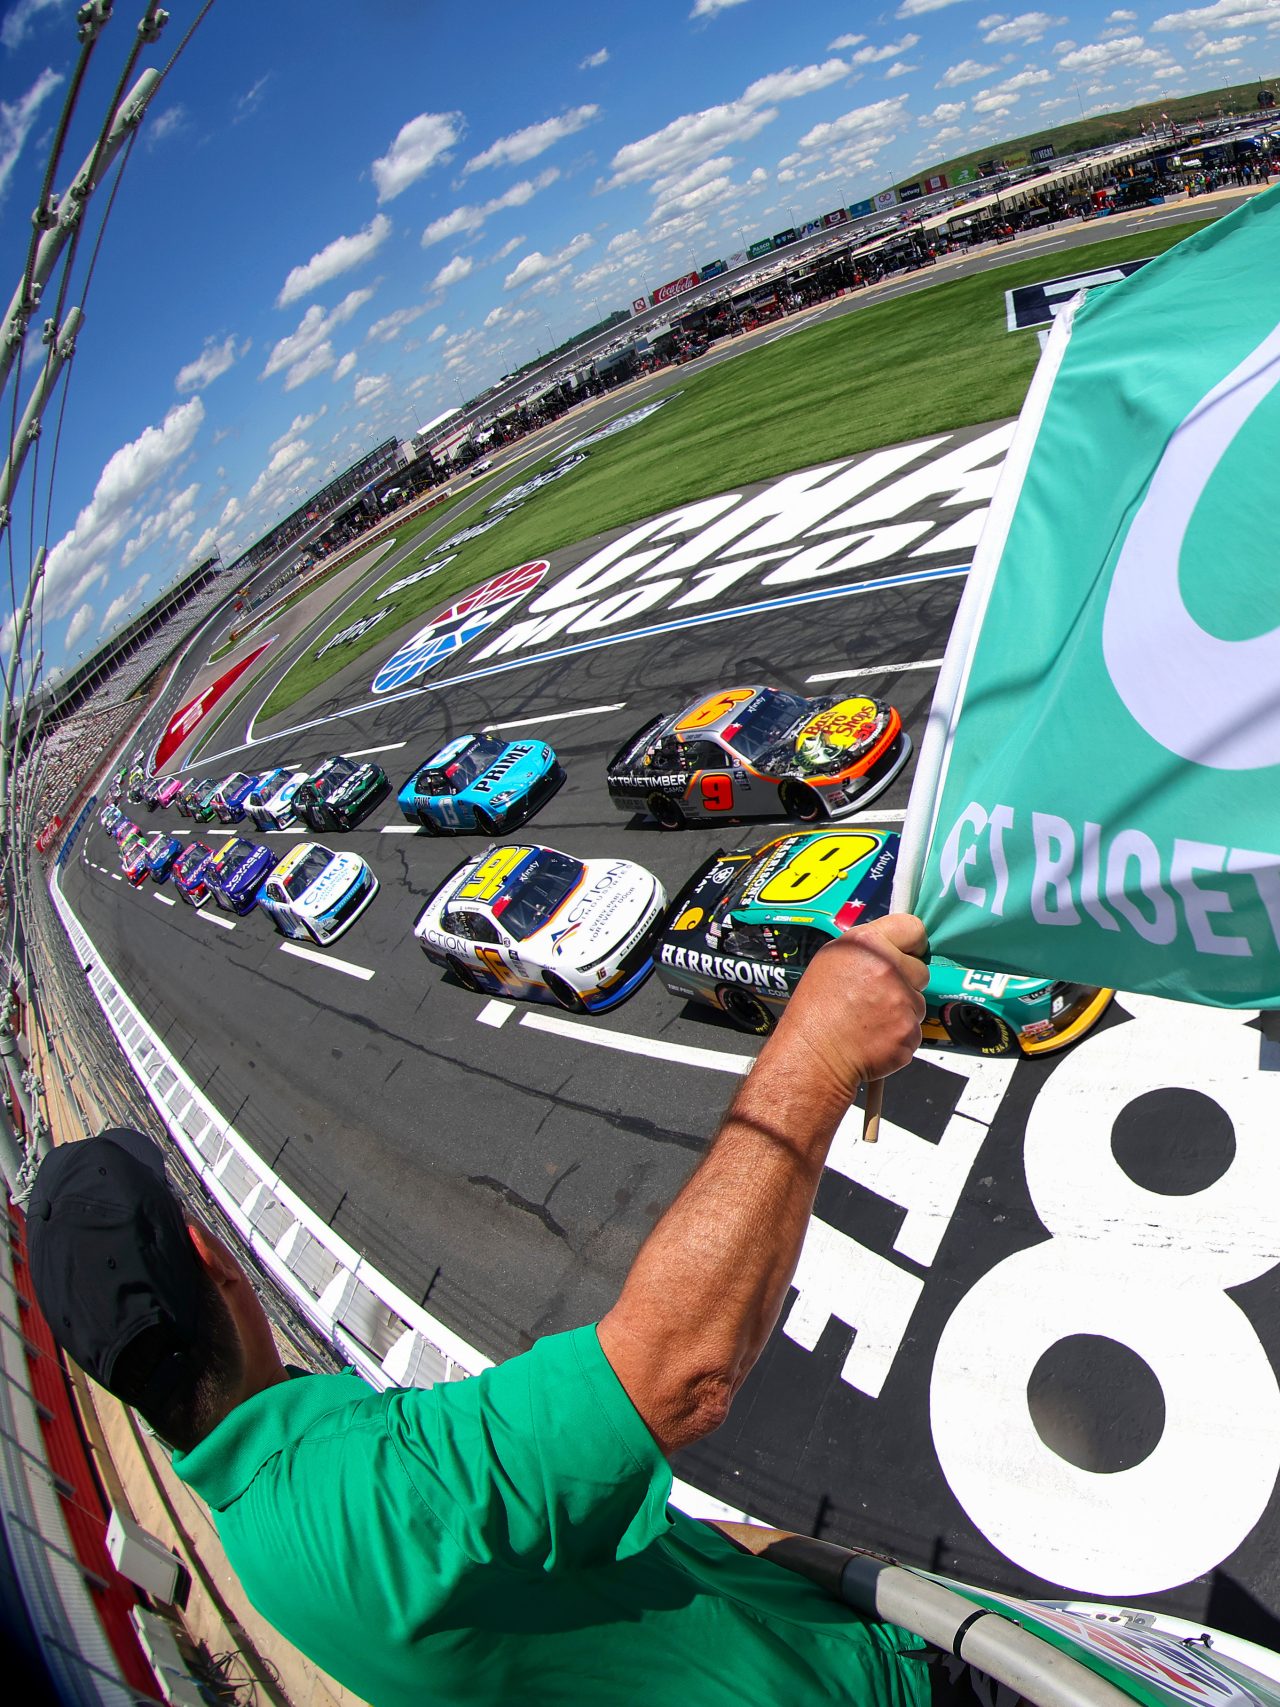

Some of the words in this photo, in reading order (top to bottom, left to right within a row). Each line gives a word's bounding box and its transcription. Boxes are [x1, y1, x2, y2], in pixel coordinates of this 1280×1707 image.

[900, 187, 920, 199] betway
[658, 275, 694, 301] Coca-Cola
[747, 696, 766, 713] xfinity
[803, 711, 839, 736] Bass
[821, 714, 848, 736] Pro
[835, 705, 875, 738] Shops
[472, 743, 535, 793] PRIME
[617, 774, 688, 788] TRUETIMBER
[700, 772, 735, 812] 9
[225, 845, 266, 889] VOYAGER
[519, 860, 540, 883] xfinity
[694, 860, 724, 894] ARIAT
[755, 833, 882, 906] 8
[868, 850, 895, 881] xfinity
[303, 858, 349, 906] Cirkul
[589, 908, 607, 932] EVERY
[606, 891, 622, 909] PART
[590, 925, 602, 942] FOR
[601, 904, 618, 926] EVERY
[618, 886, 636, 904] DOOR
[420, 927, 469, 953] ACTION
[619, 908, 657, 957] CAMARO
[474, 945, 524, 988] 16
[596, 966, 607, 980] 16
[661, 943, 789, 991] HARRISON'S
[938, 992, 986, 1004] GOODYEAR
[1052, 996, 1064, 1013] 8
